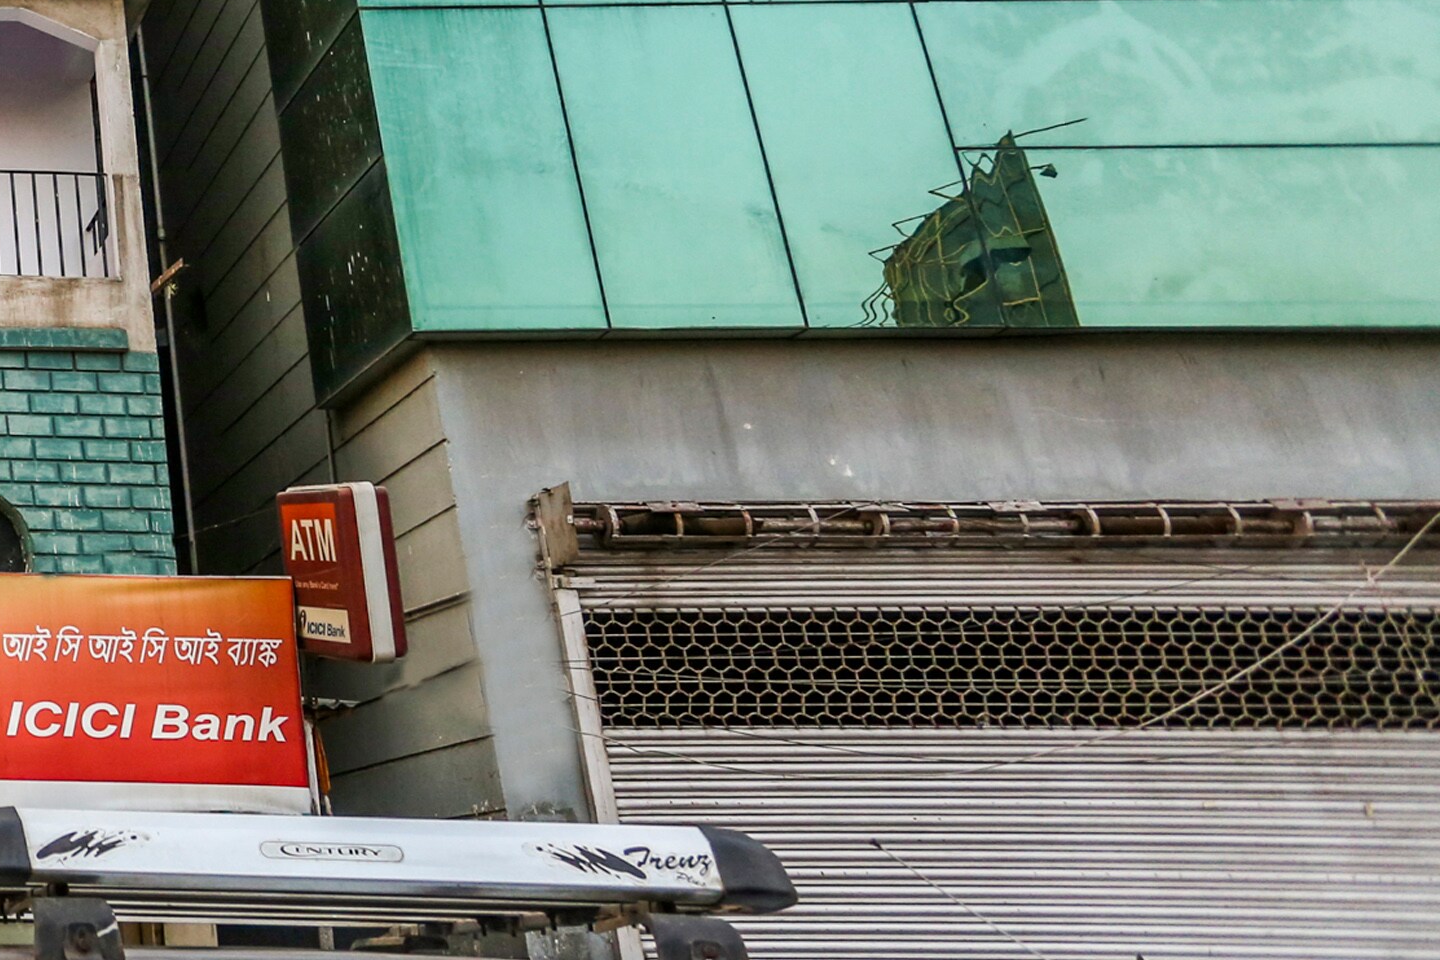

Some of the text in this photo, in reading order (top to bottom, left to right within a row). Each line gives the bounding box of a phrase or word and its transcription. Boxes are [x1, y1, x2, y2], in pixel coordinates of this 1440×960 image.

[291, 518, 337, 562] ATM
[2, 625, 51, 662] আই
[53, 625, 83, 662] সি
[88, 626, 137, 663] আই
[139, 627, 169, 664] সি
[174, 628, 223, 666] আই
[307, 622, 346, 639] ICICI Bank
[6, 701, 289, 743] ICICI Bank
[623, 846, 712, 875] Trenz
